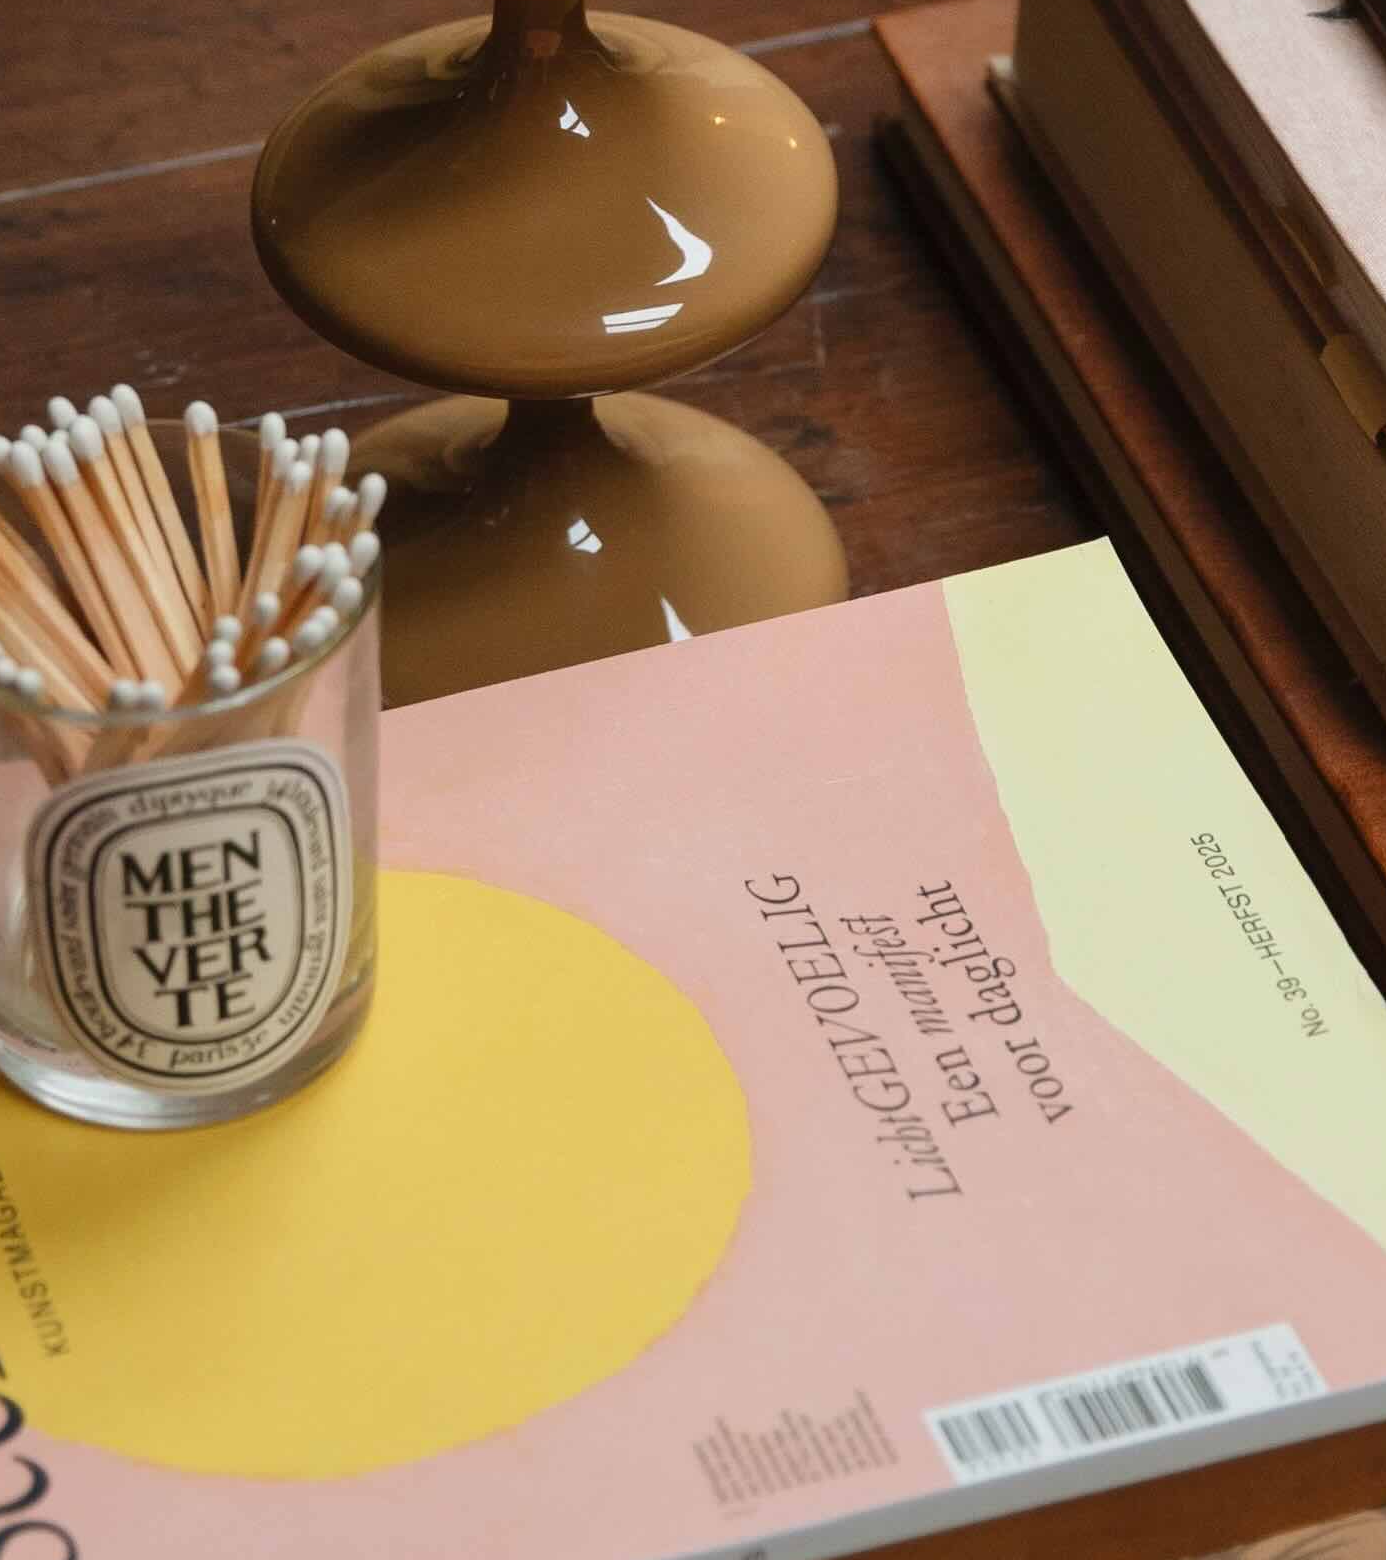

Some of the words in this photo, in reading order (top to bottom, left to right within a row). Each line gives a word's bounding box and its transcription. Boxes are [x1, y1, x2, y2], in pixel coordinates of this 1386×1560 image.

[119, 829, 262, 897] MEN
[1190, 831, 1235, 880] 2025
[123, 878, 267, 943] THE
[132, 925, 273, 986] VER
[839, 914, 954, 1036] manifest
[916, 879, 1022, 1026] daglicht
[153, 972, 257, 1028] TE
[934, 1043, 1000, 1128] Een
[1004, 1036, 1074, 1125] voor
